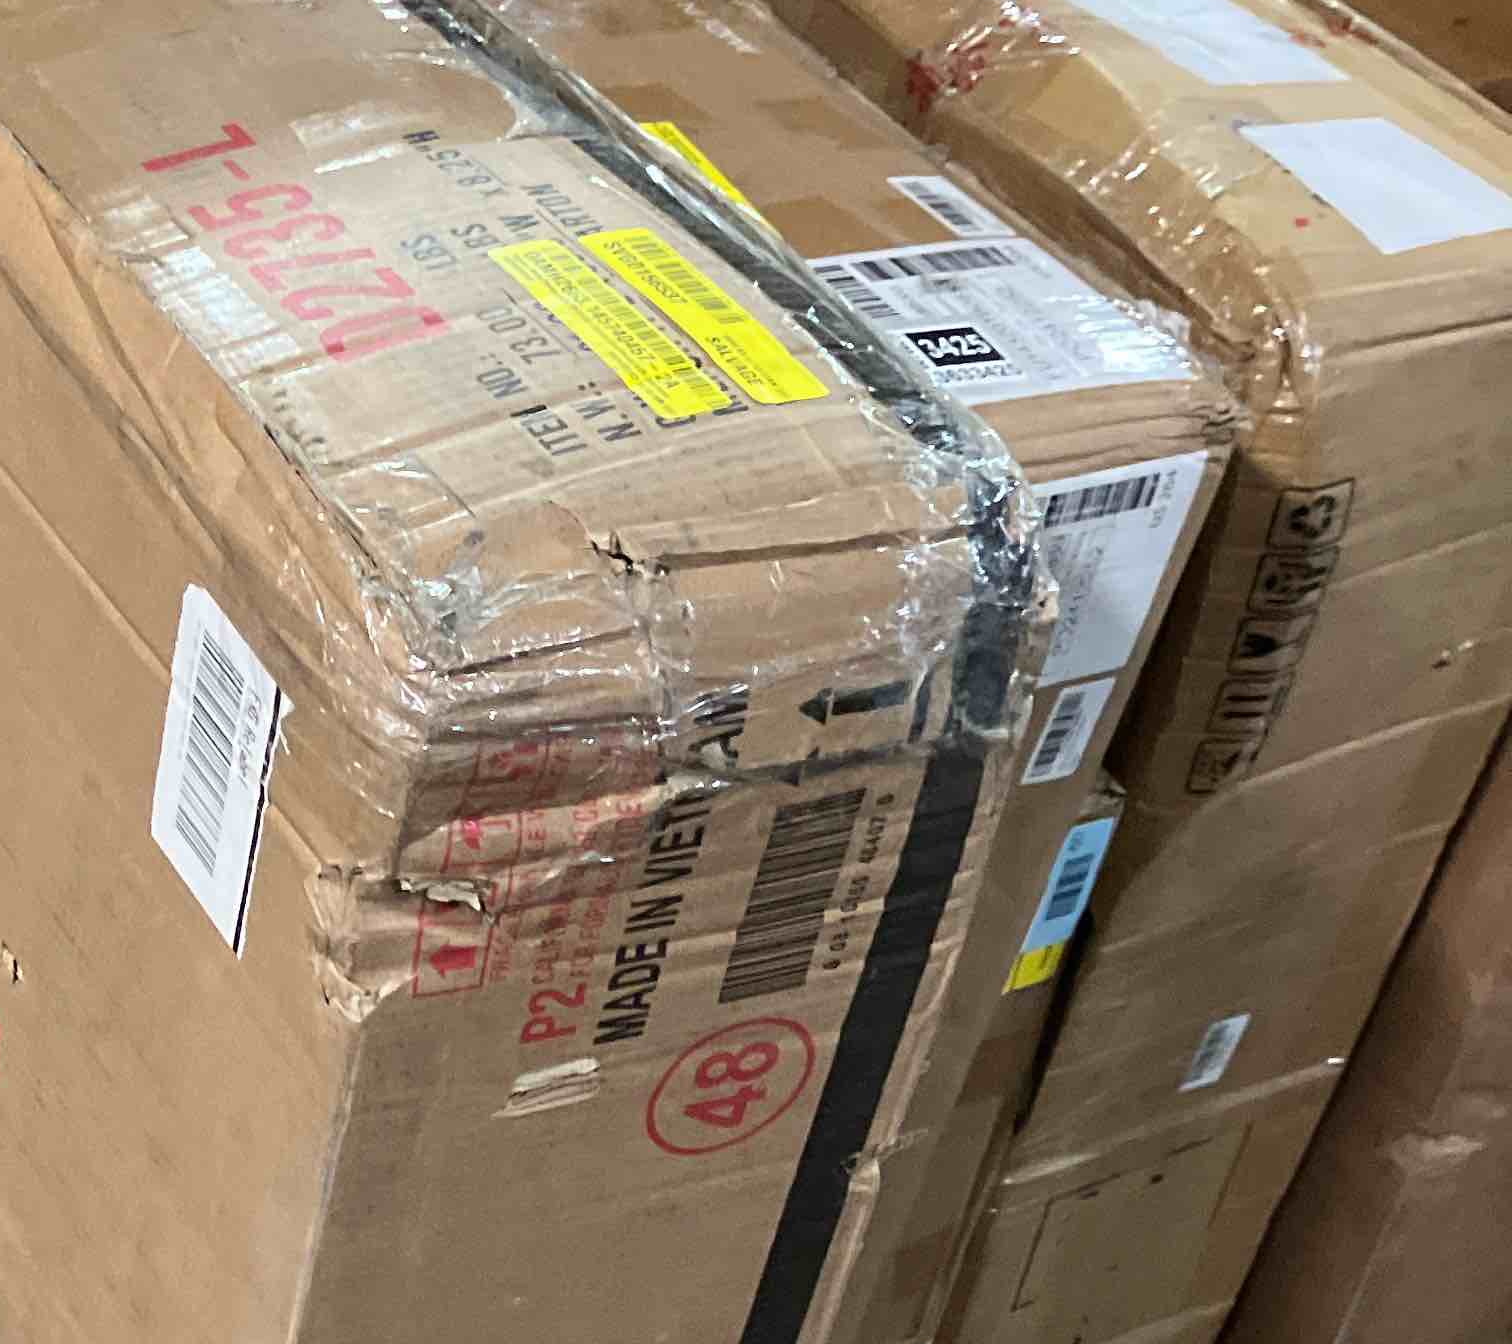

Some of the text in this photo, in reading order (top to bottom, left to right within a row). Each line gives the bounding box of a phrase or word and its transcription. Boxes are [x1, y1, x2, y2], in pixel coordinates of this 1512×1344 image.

[400, 234, 563, 366] 73.00 LBS
[915, 332, 992, 362] 3425
[509, 403, 588, 457] ITEM
[628, 891, 684, 934] IN
[519, 982, 586, 1046] P2
[593, 935, 668, 1046] MADE
[684, 1042, 781, 1128] 48
